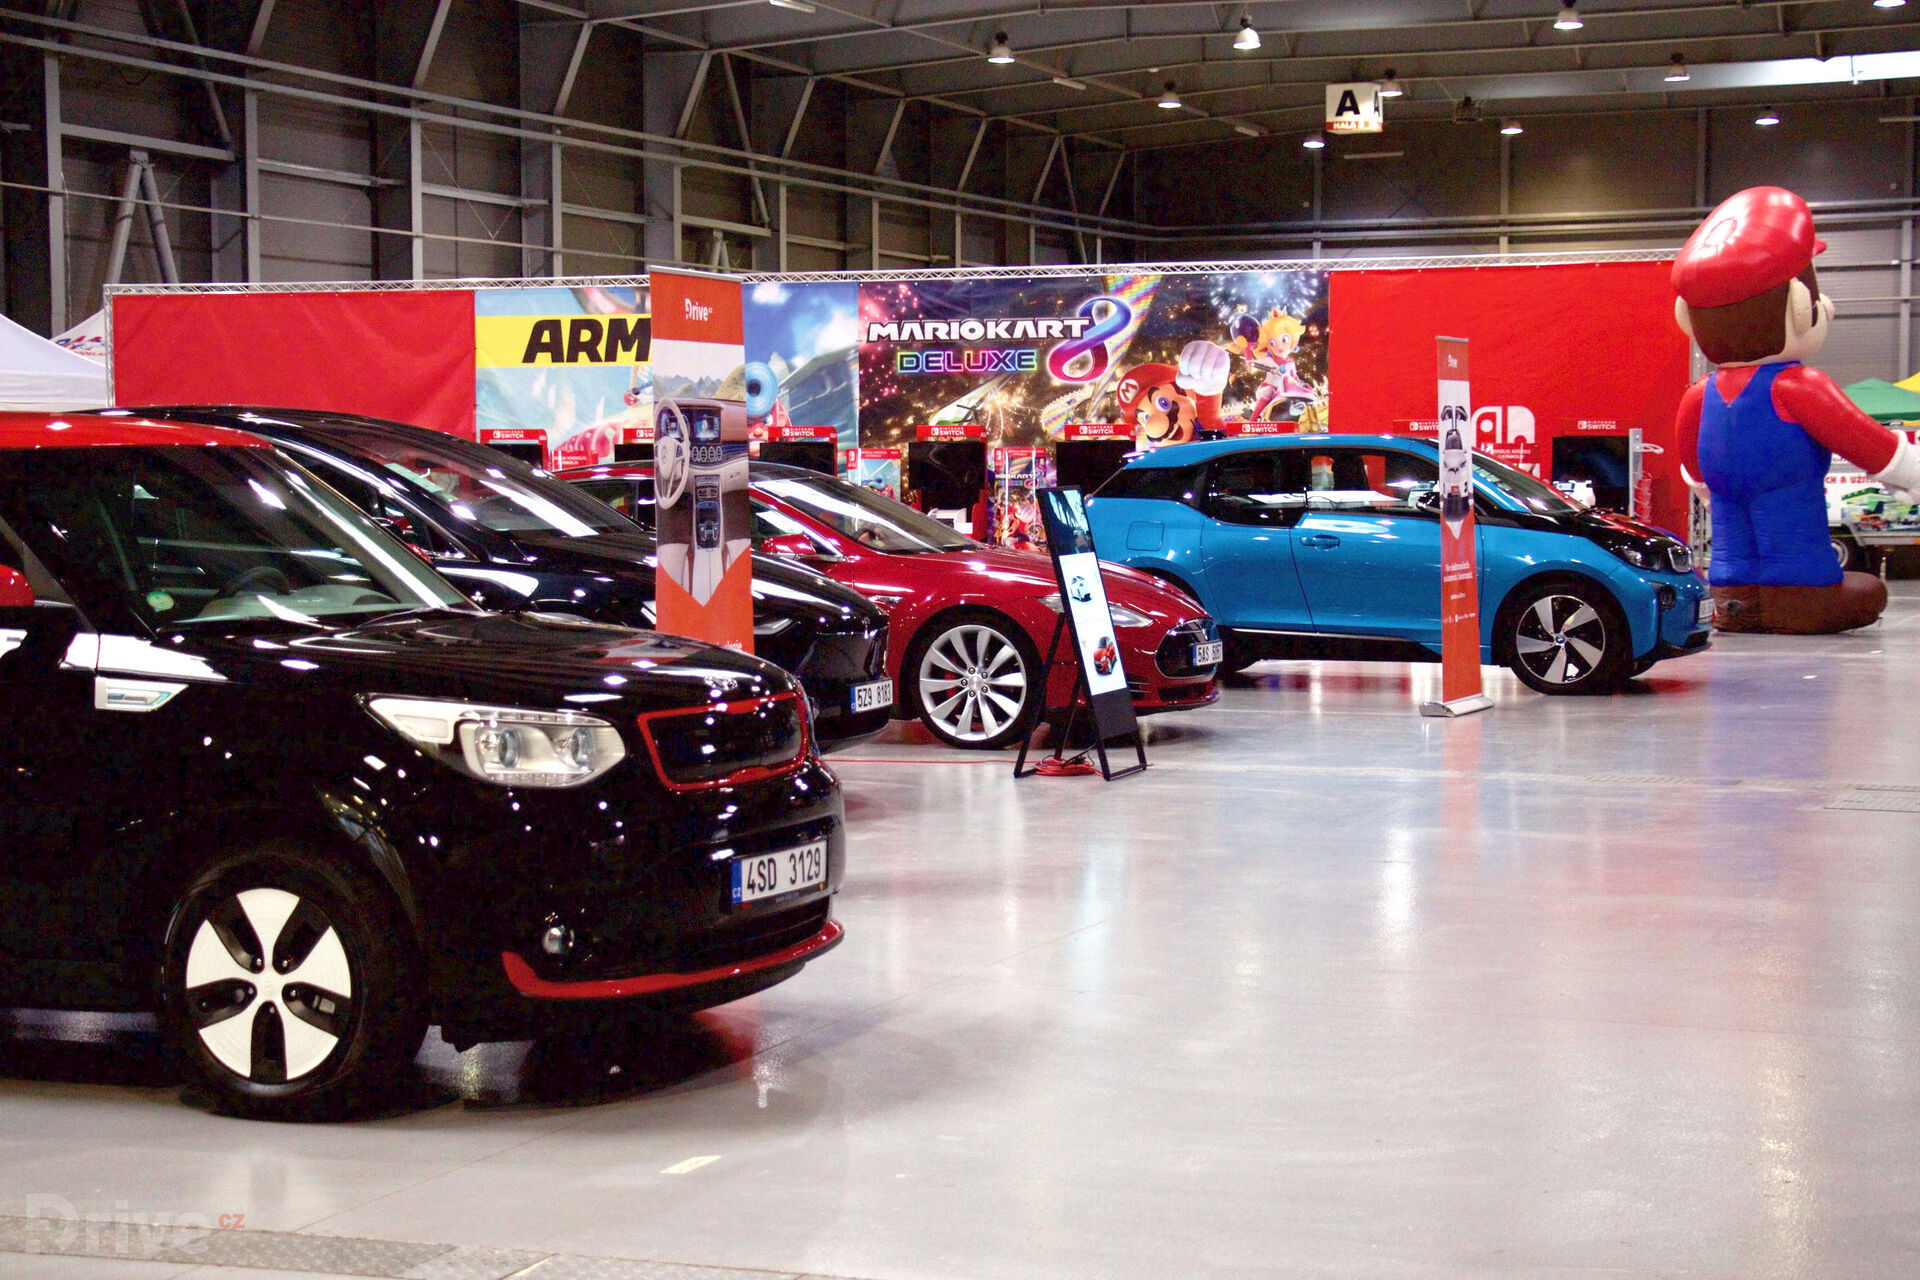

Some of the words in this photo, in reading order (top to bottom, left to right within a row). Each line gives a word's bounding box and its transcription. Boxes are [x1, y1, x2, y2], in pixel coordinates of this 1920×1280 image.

[1335, 90, 1360, 117] A
[1047, 297, 1132, 383] 8
[896, 349, 1038, 373] DELUXE
[857, 687, 873, 708] 5Z9
[747, 857, 777, 895] 4SD
[789, 846, 821, 885] 3129
